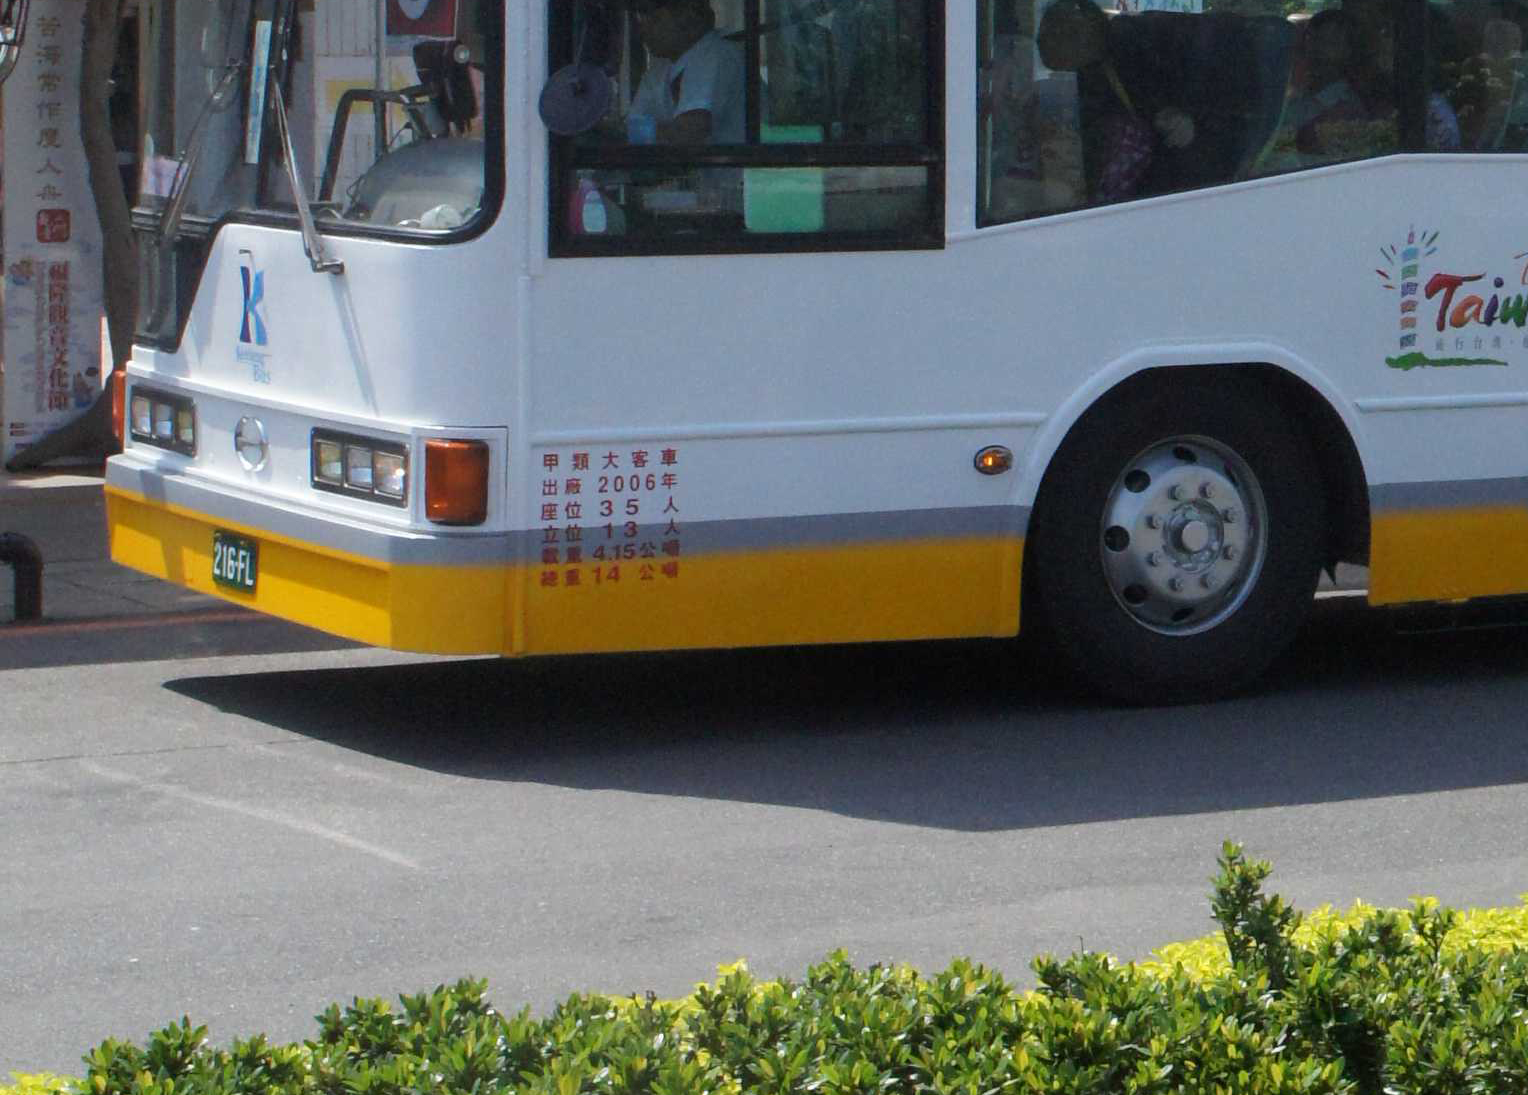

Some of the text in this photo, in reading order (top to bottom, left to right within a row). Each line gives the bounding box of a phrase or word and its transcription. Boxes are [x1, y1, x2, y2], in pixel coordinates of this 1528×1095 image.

[543, 448, 678, 472] 甲類大客車
[213, 541, 254, 586] 216-FL
